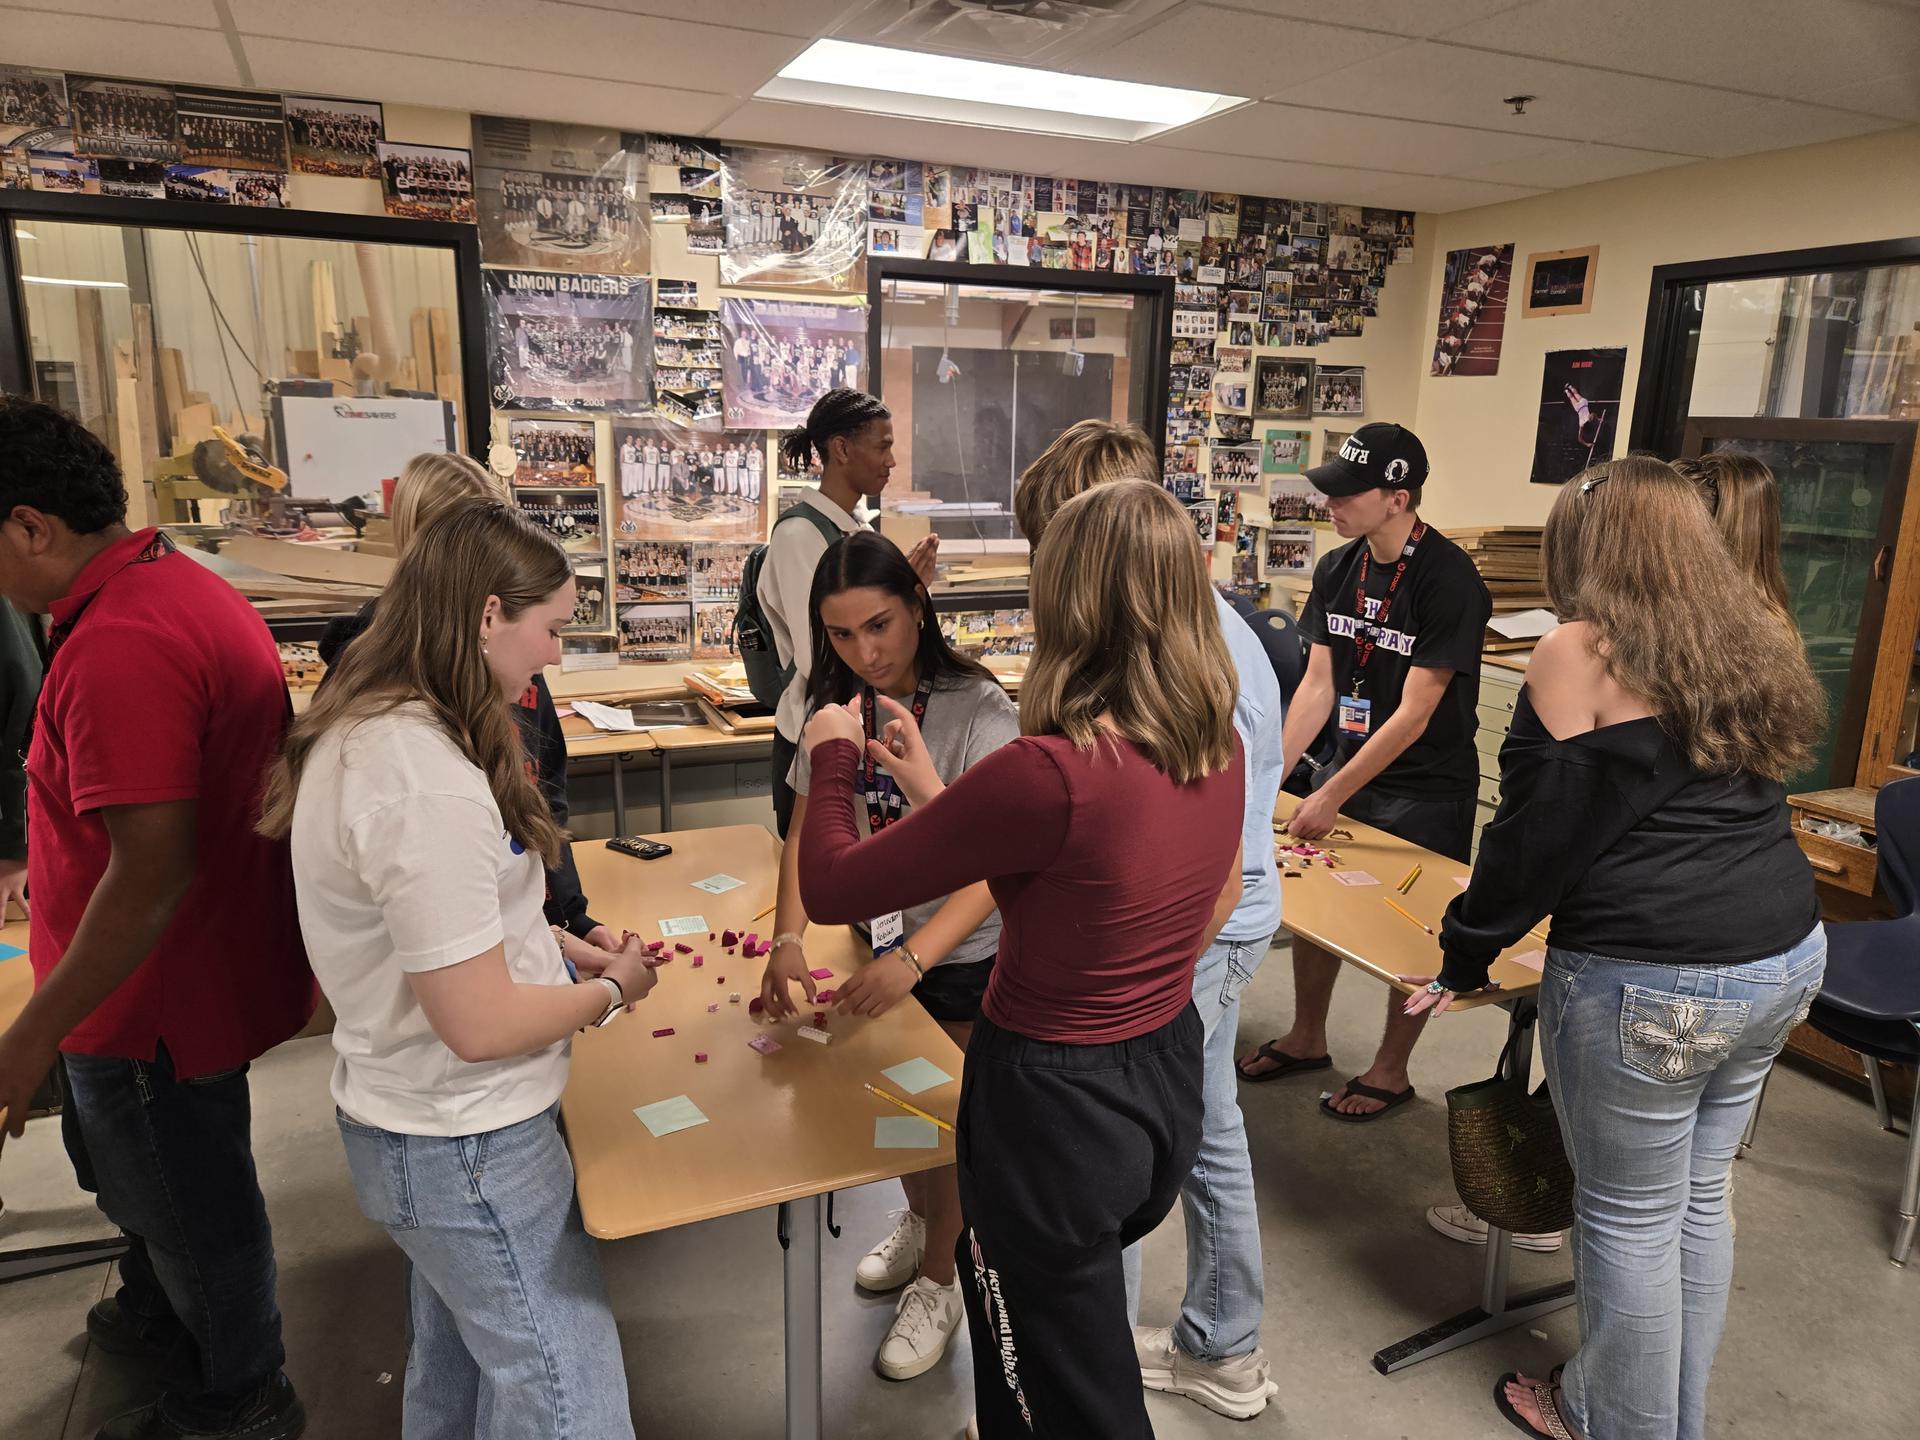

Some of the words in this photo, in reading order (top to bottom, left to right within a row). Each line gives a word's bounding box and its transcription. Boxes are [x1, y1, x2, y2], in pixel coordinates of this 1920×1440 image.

[26, 131, 54, 146] 2019
[77, 136, 178, 158] VOLLEYBALL
[508, 274, 556, 291] LIMON
[559, 277, 629, 295] BADGERS
[583, 398, 606, 407] 2003
[1390, 571, 1401, 592] CIRCLE
